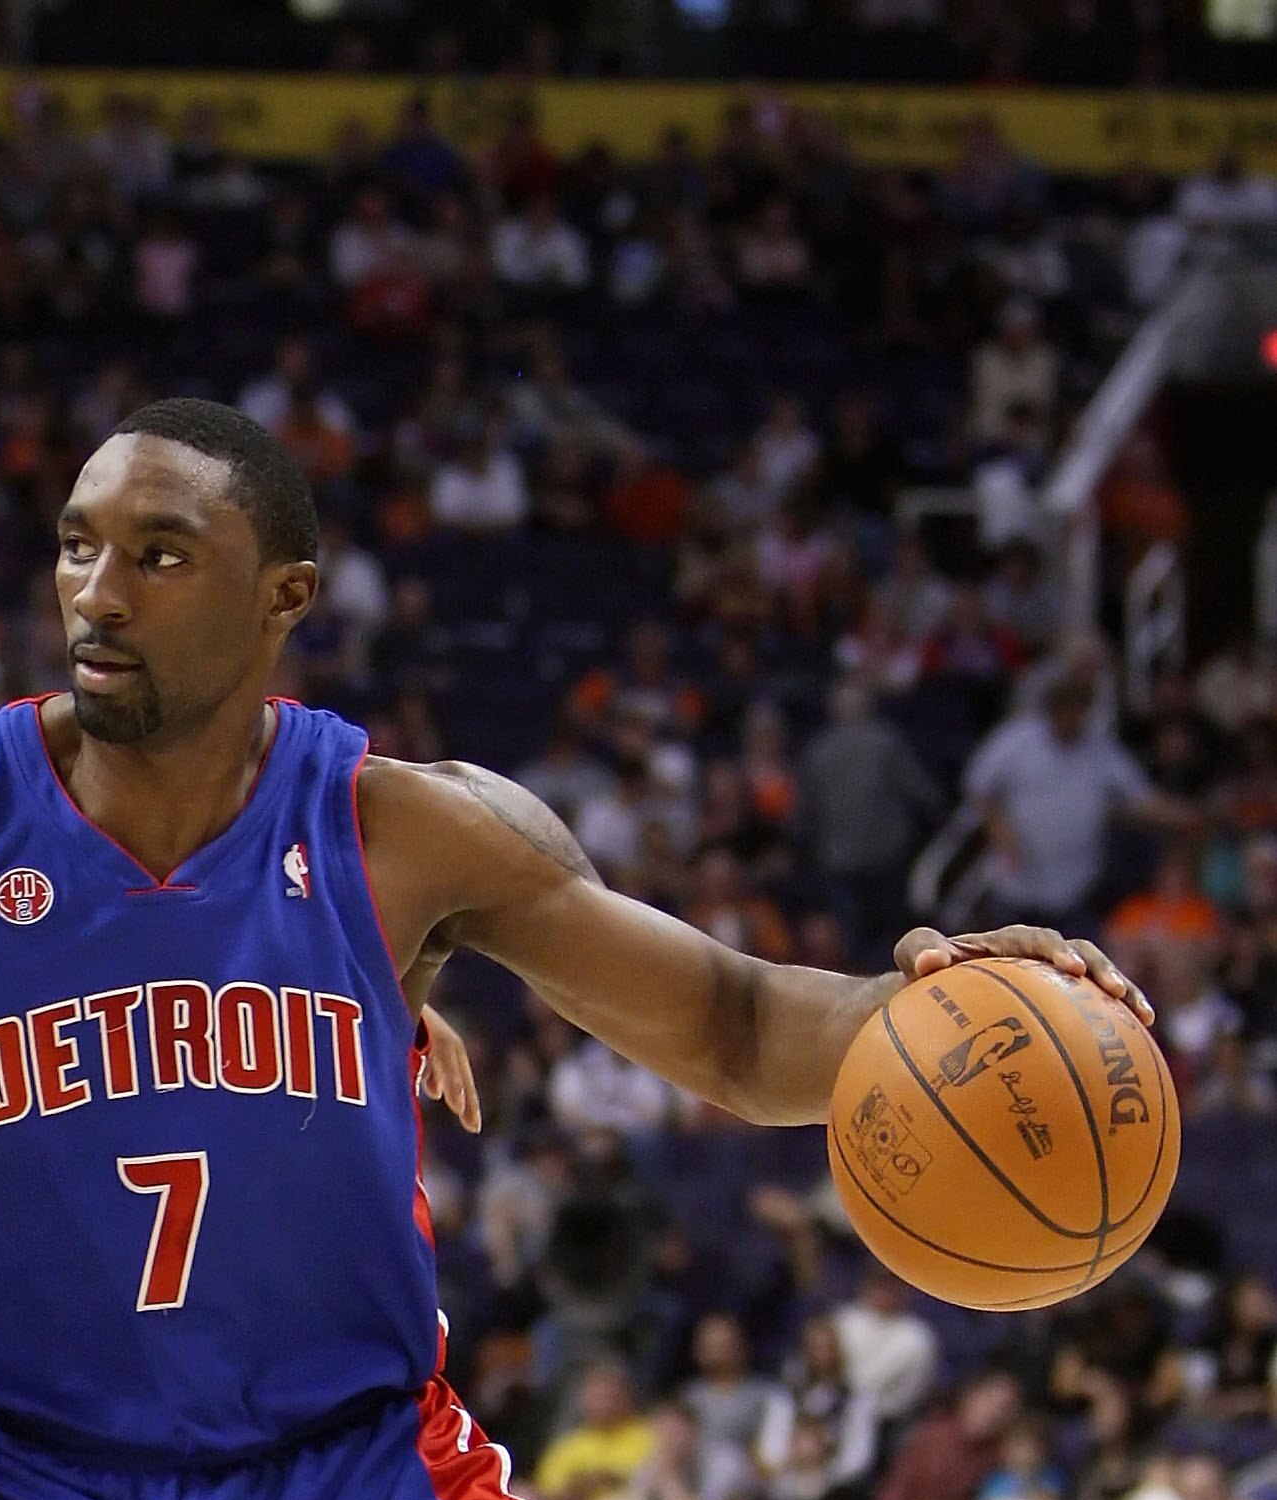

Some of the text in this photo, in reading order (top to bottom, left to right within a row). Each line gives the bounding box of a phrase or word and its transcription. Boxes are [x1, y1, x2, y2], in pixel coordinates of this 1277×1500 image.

[9, 873, 37, 899] CD
[15, 898, 33, 921] 2
[116, 1150, 210, 1313] 7
